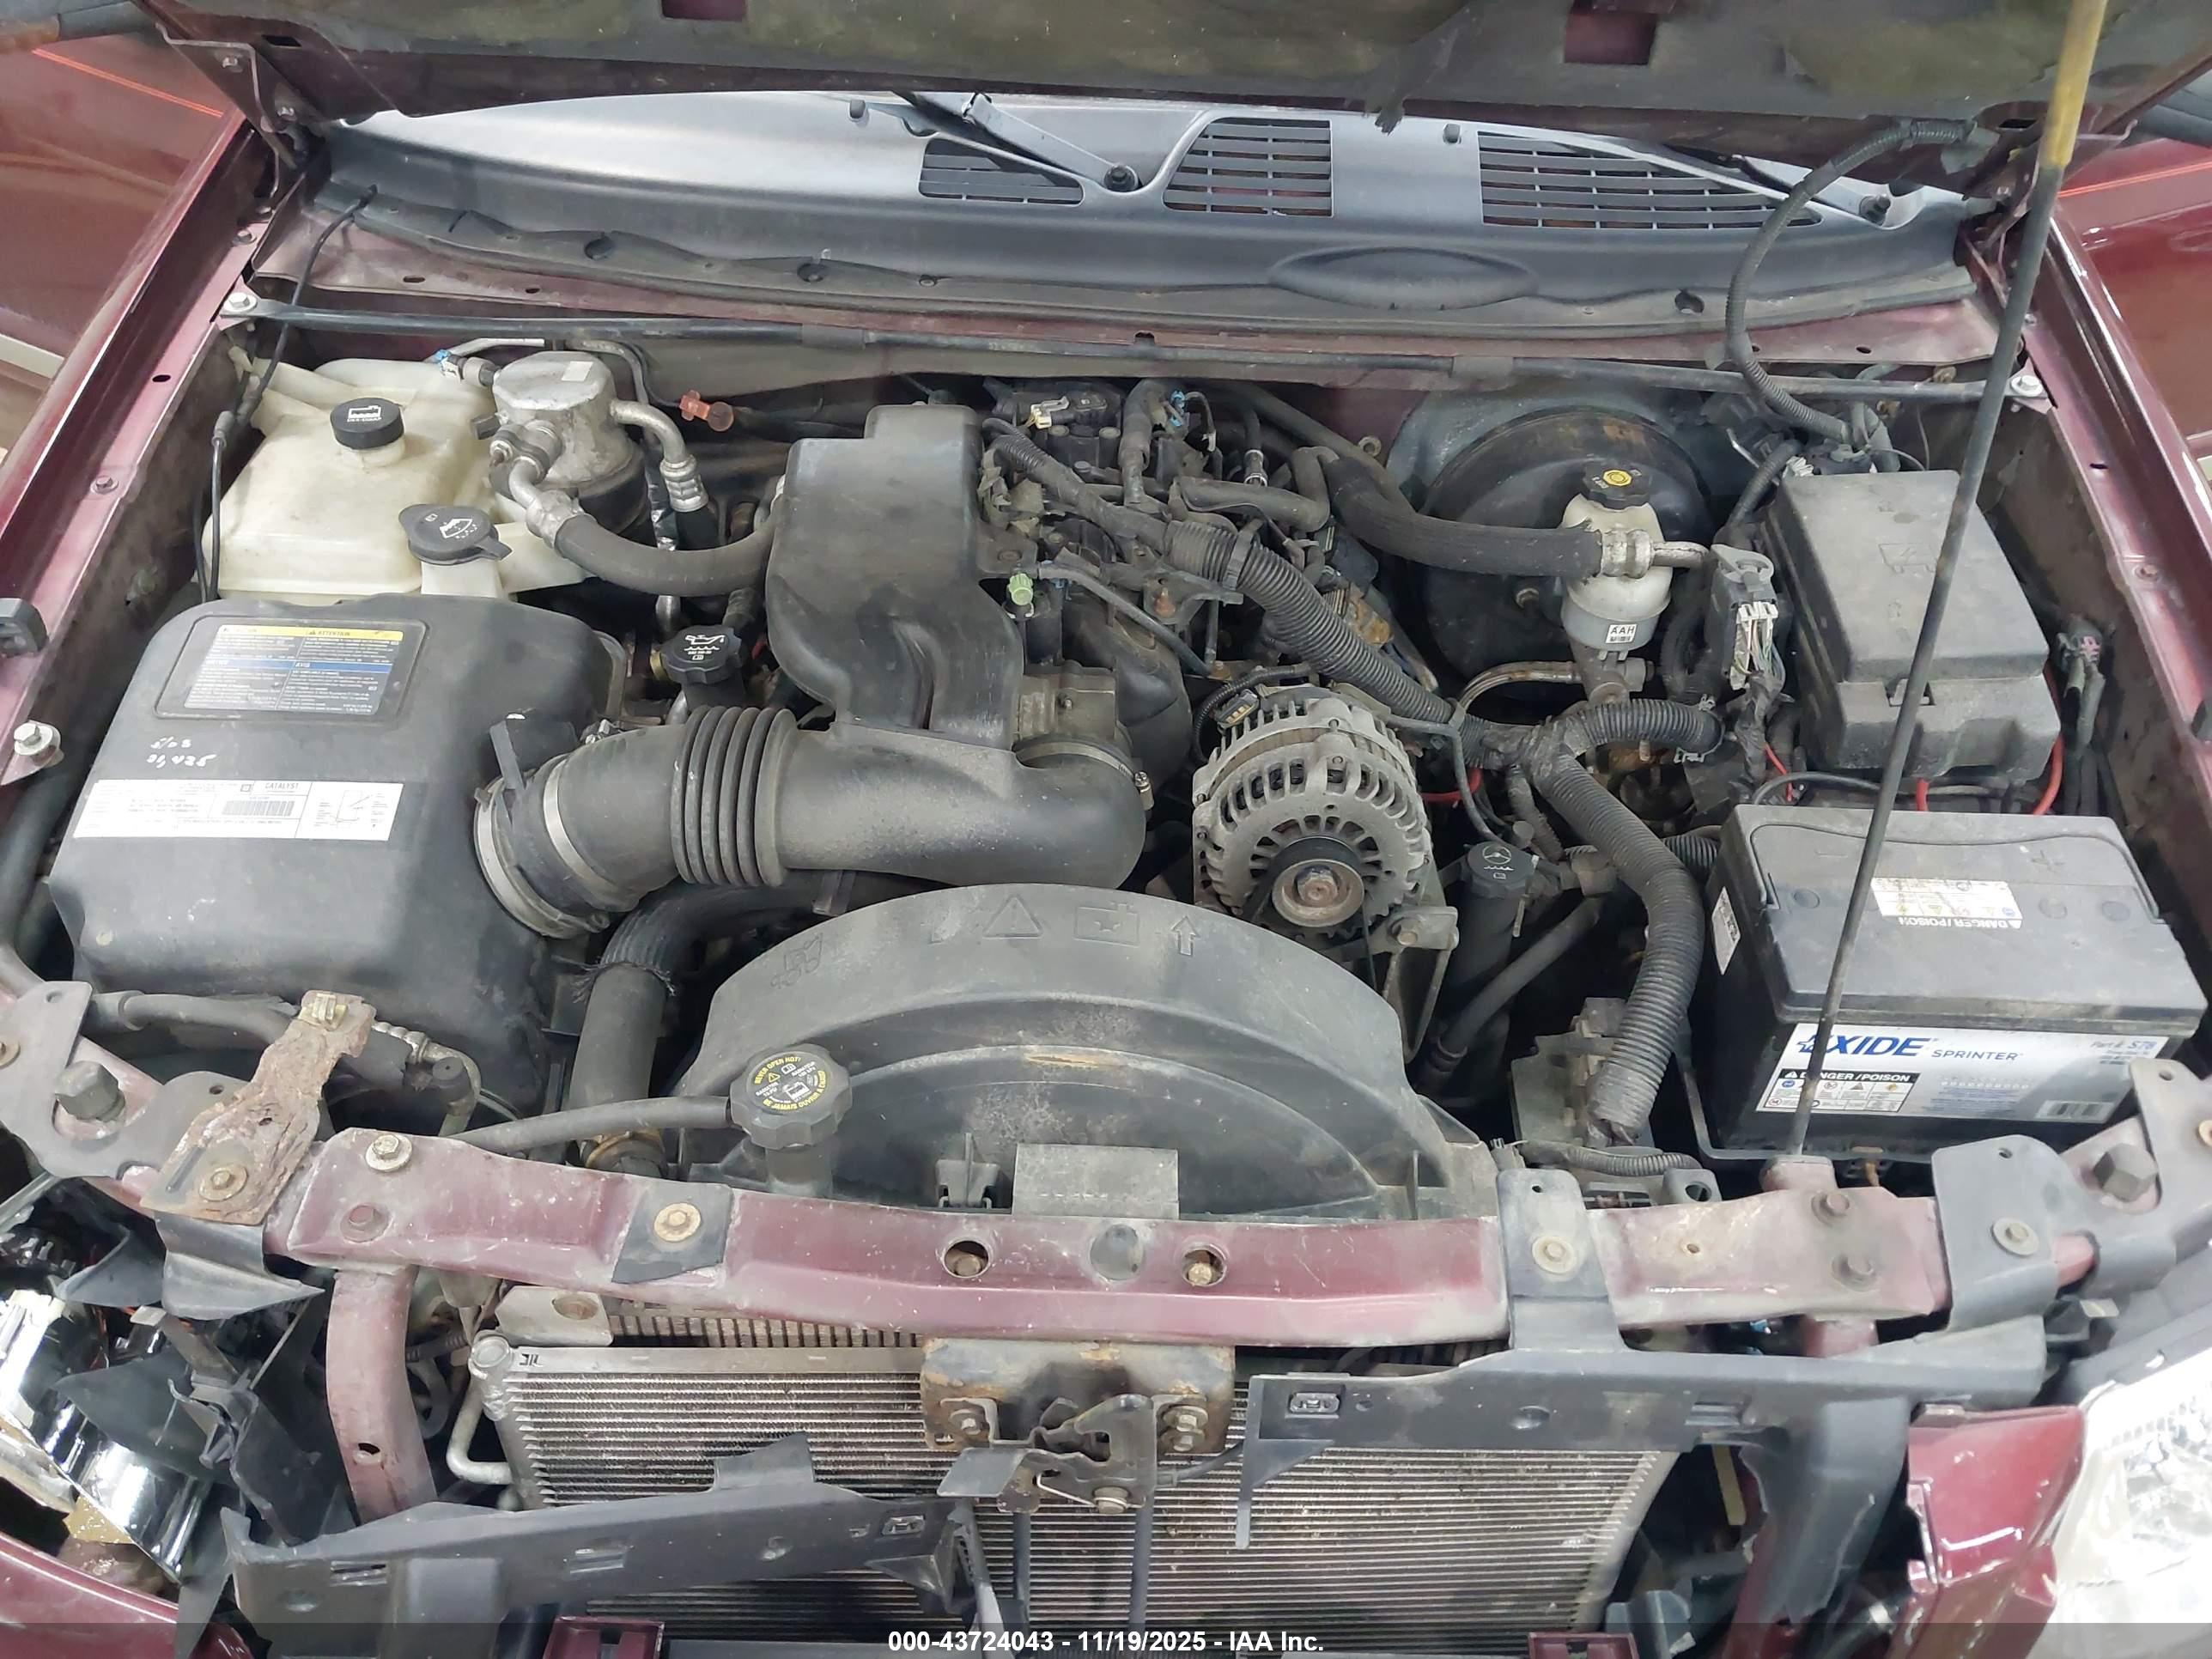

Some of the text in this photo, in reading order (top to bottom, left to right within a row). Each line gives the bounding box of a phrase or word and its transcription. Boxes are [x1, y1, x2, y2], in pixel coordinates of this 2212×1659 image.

[1930, 1049, 2019, 1061] SPRINTER
[767, 1058, 785, 1069] OPEN
[1800, 1072, 1855, 1081] DNGER
